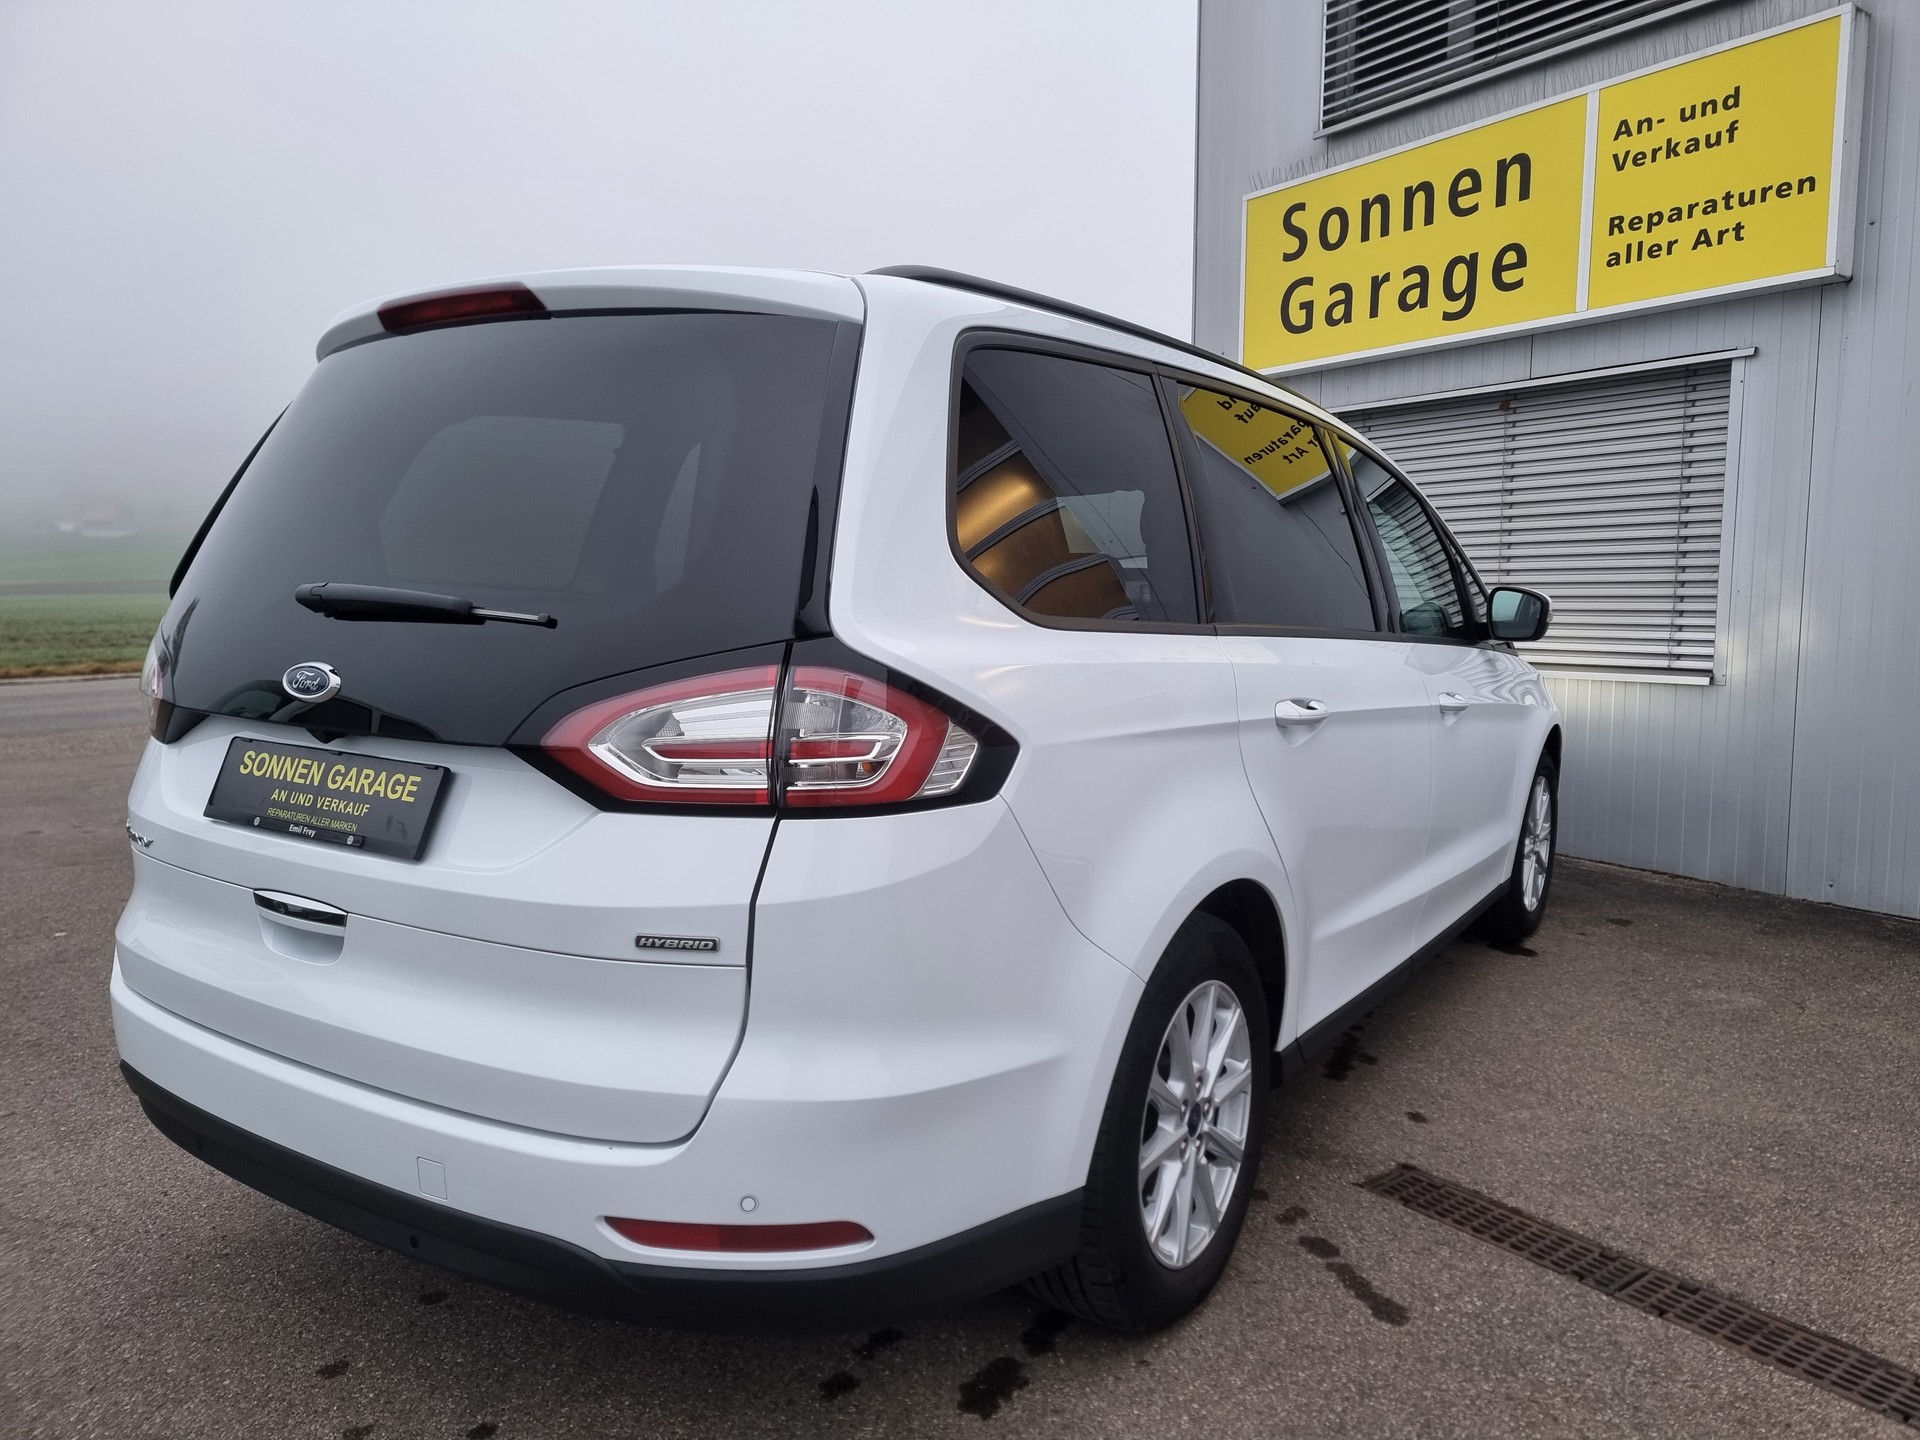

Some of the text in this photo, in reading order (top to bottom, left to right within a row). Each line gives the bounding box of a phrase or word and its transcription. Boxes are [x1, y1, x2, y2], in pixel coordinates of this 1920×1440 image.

[1612, 85, 1741, 142] An- und
[1612, 119, 1740, 172] Verkauf
[1281, 152, 1533, 263] Sonnen
[1607, 175, 1816, 237] Reparaturen
[1606, 221, 1746, 268] aller Art
[1280, 242, 1528, 335] Garage
[292, 670, 321, 691] Ford
[239, 750, 422, 803] SONNEN GARAGE
[266, 807, 358, 832] REPARATUREN ALLER MARKEN
[270, 788, 371, 817] AN UND VERKAUF
[289, 824, 317, 838] Emil Frey
[638, 937, 714, 950] HYBRID
